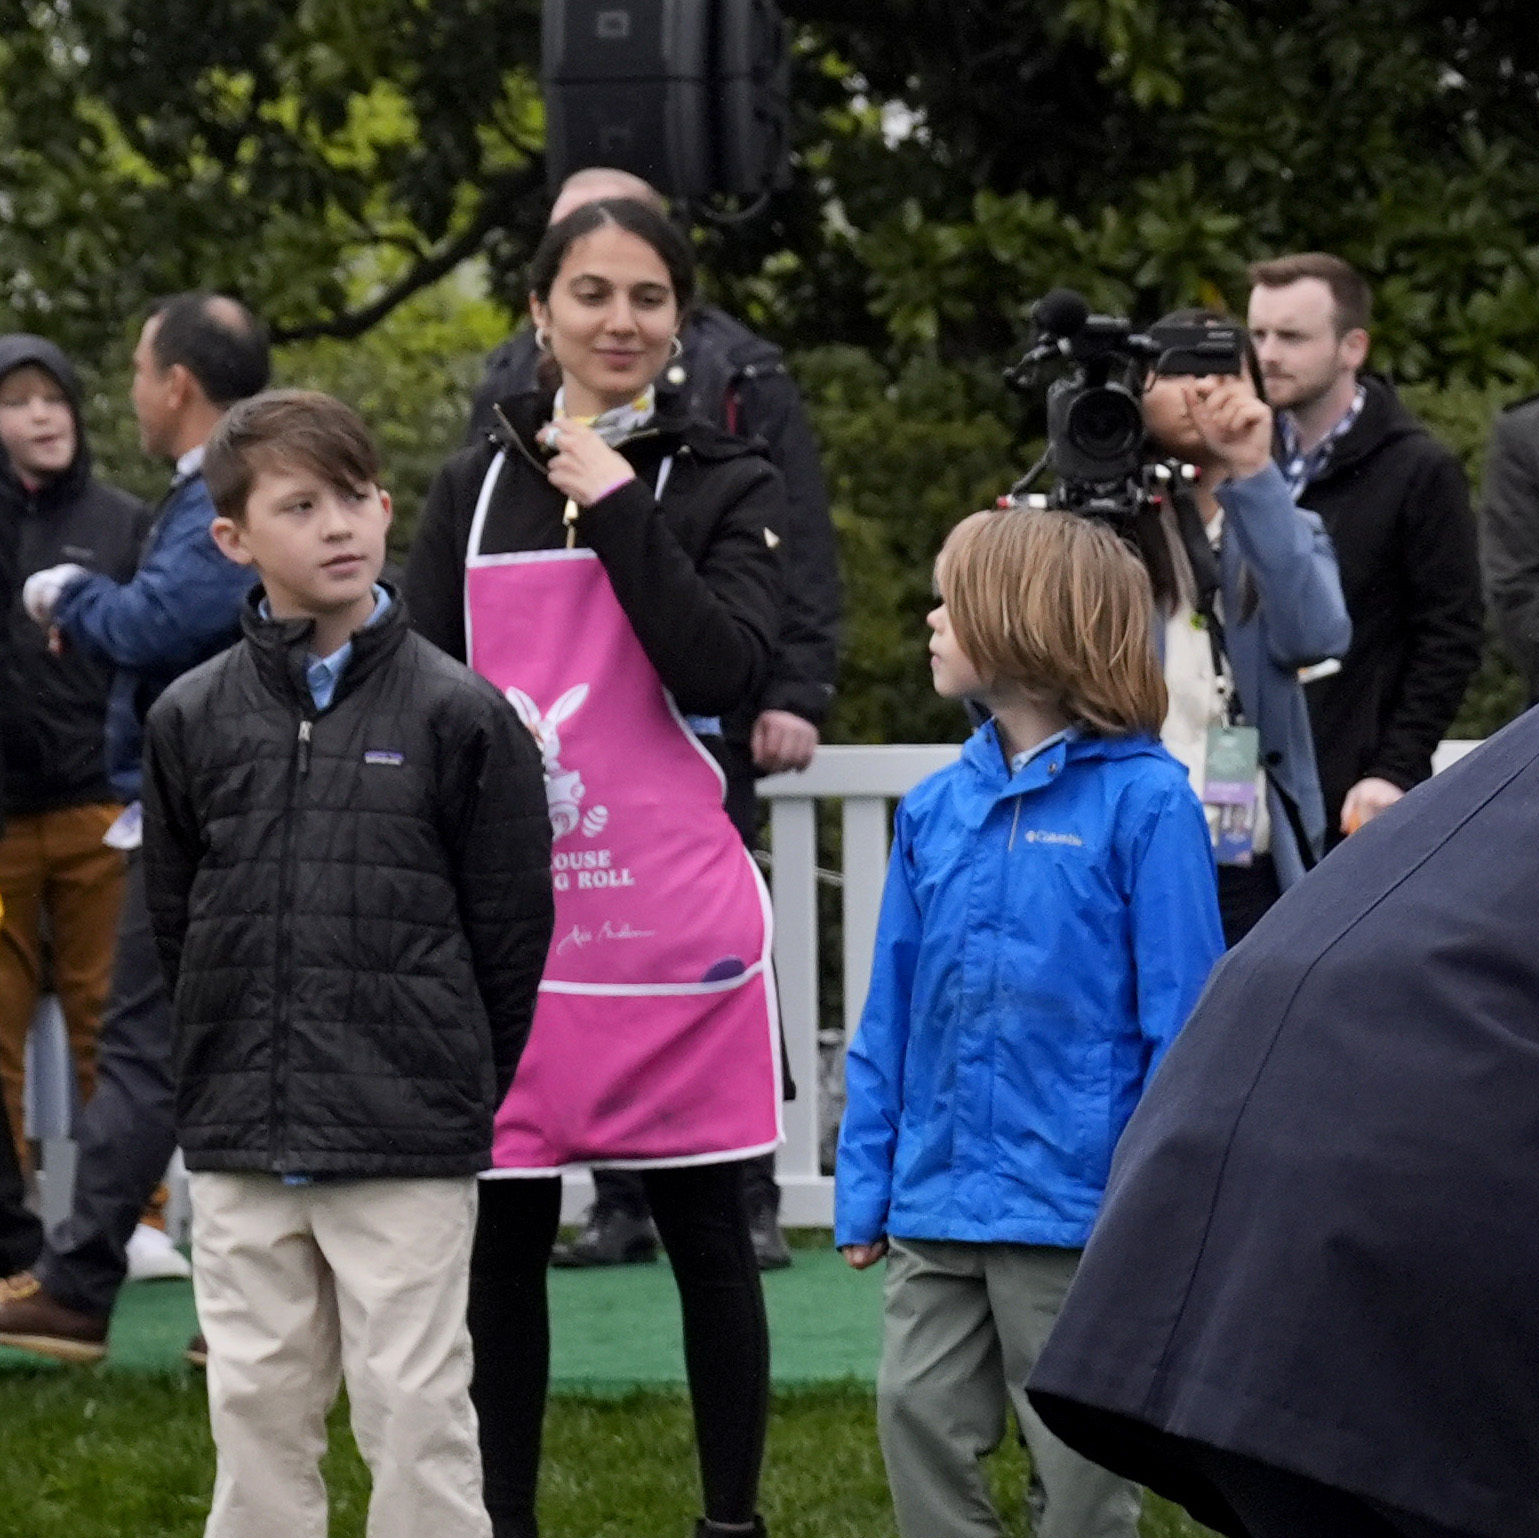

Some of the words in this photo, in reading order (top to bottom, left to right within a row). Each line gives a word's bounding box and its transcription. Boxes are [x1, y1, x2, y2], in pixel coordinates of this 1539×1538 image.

[551, 850, 612, 871] OUSE
[554, 872, 570, 891] G
[578, 868, 636, 889] ROLL
